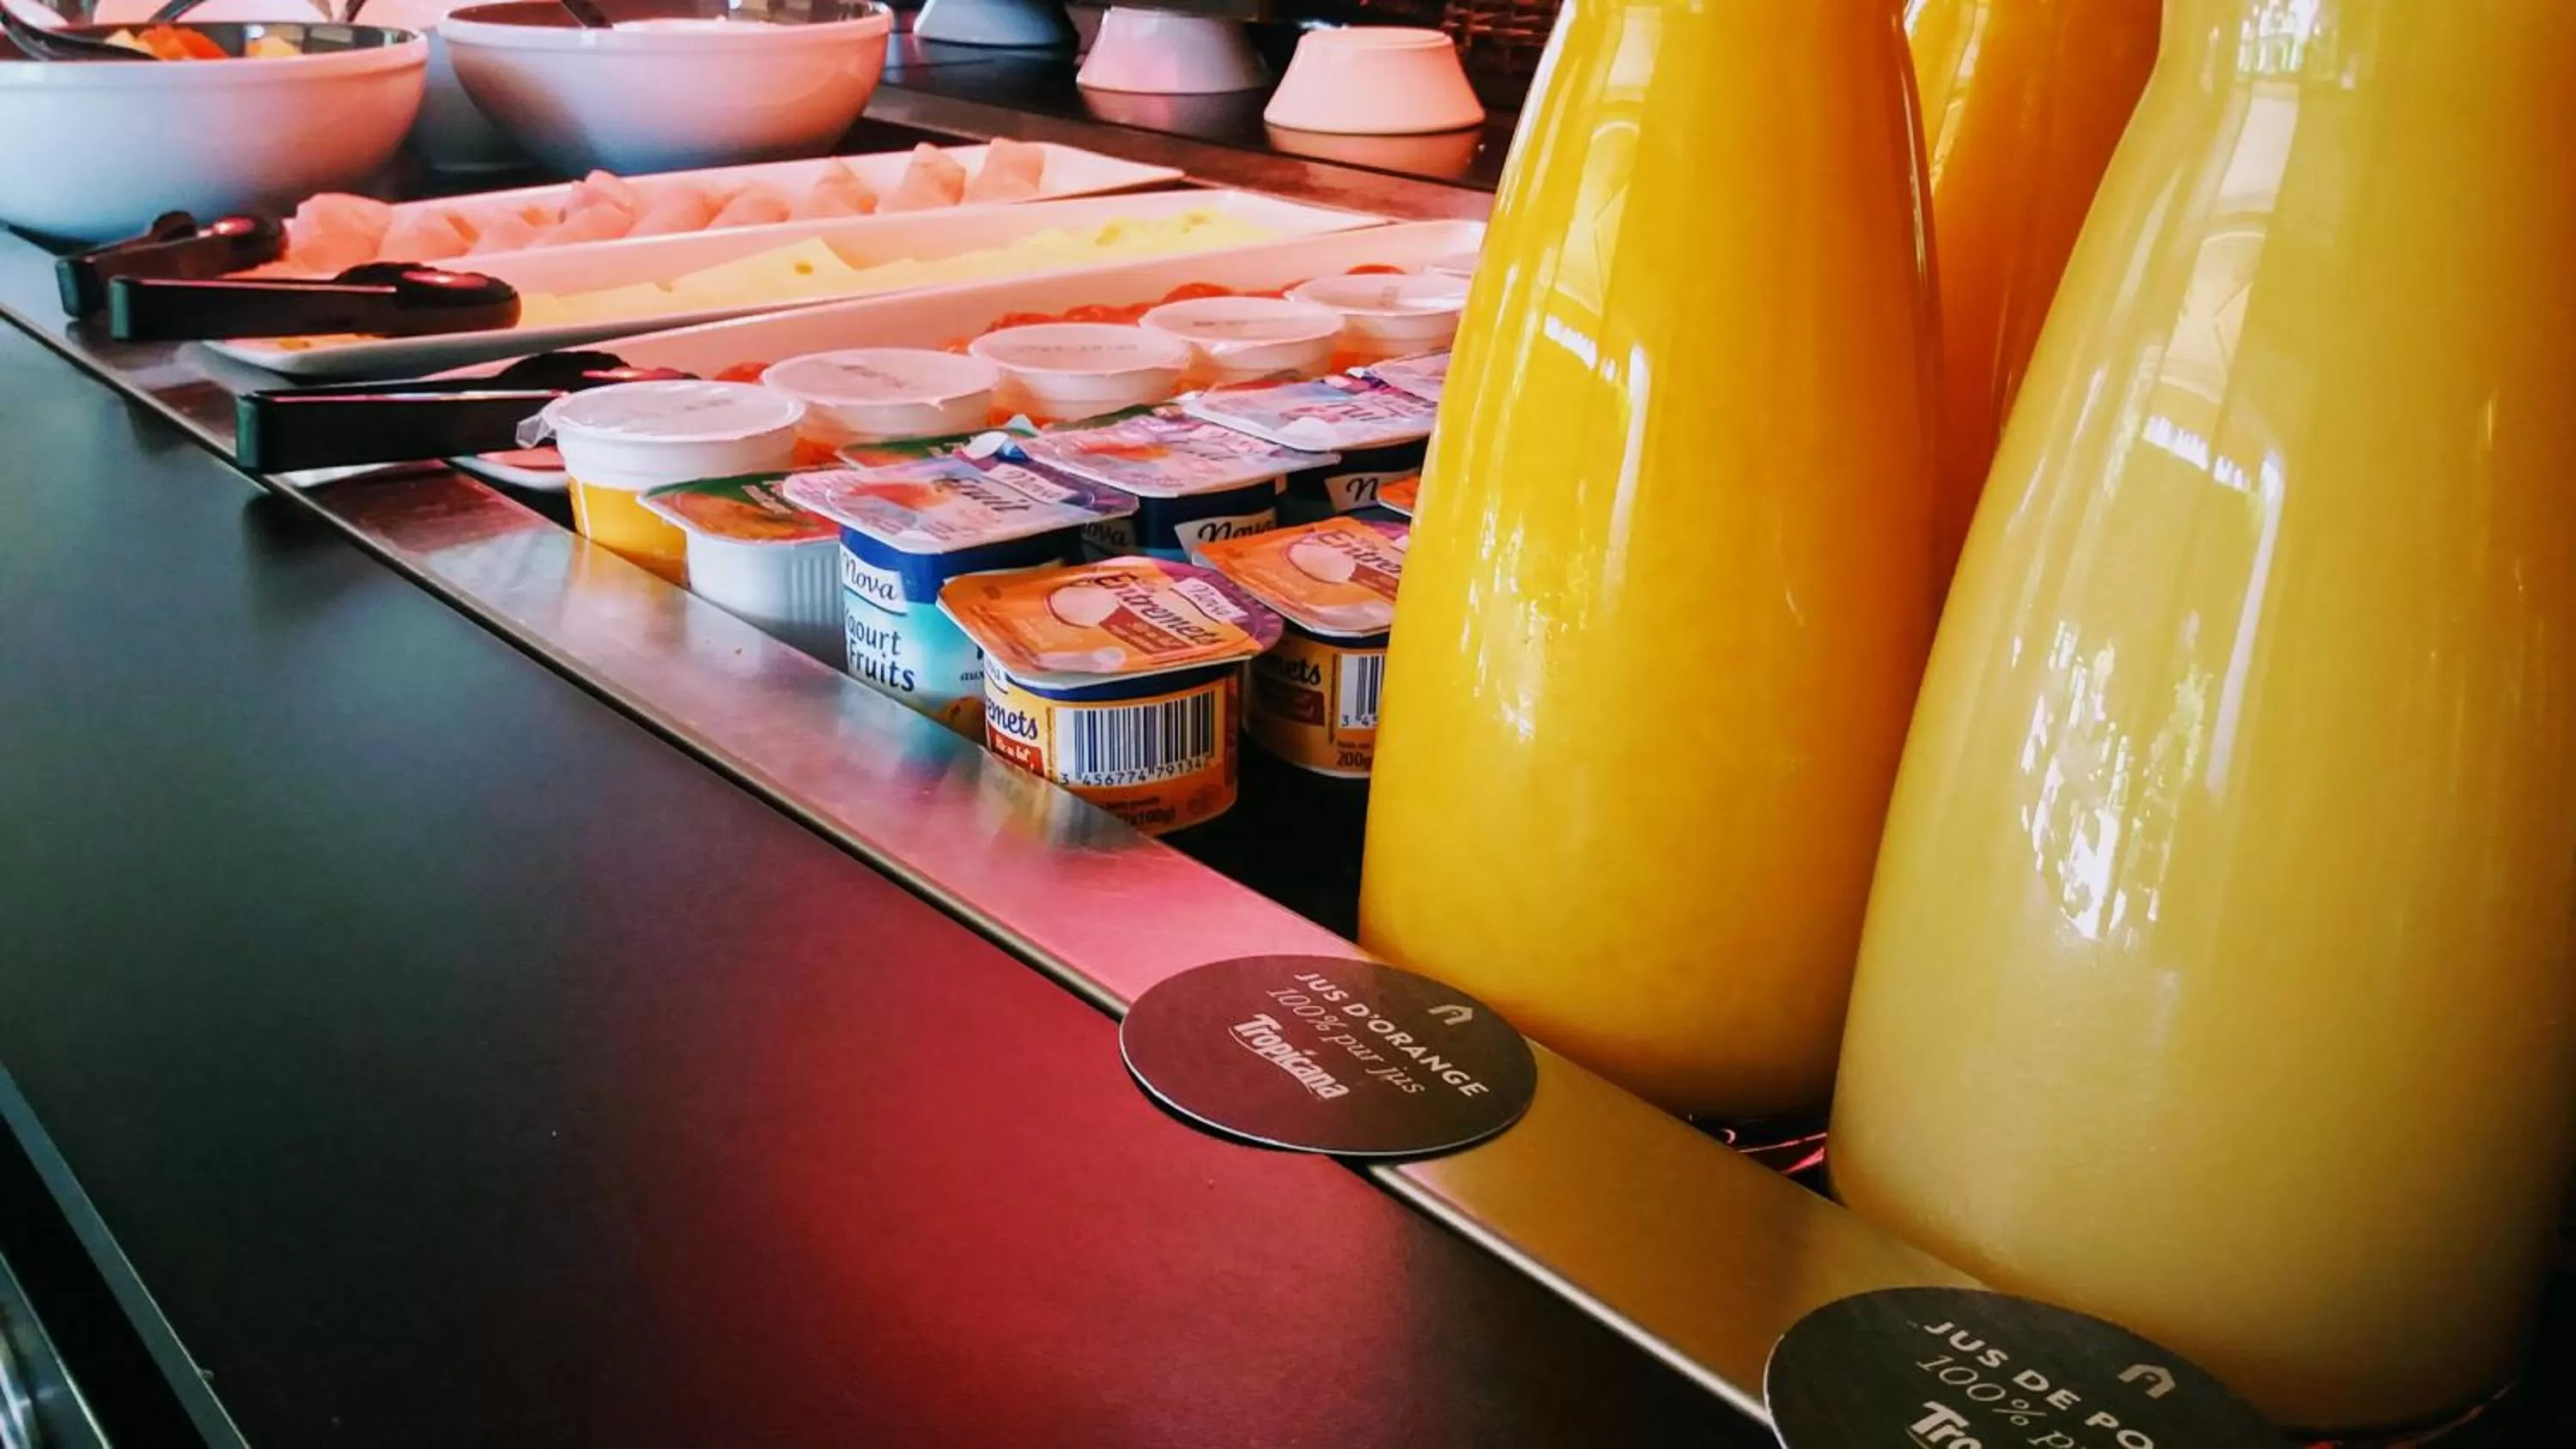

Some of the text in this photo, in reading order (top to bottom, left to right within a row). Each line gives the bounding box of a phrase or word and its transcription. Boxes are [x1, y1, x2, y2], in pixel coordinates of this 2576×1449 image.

[843, 552, 896, 601] Nova
[847, 608, 901, 656] aourt
[849, 638, 915, 693] Fruits
[1083, 770, 1146, 786] 456774
[1231, 1012, 1351, 1100] Tropicana
[1265, 986, 1425, 1096] 100% pur jus
[1295, 972, 1490, 1099] JUS D'ORANGE
[1915, 1354, 2048, 1427] 100%
[1923, 1320, 2009, 1368] JUS
[2012, 1367, 2082, 1411] DE
